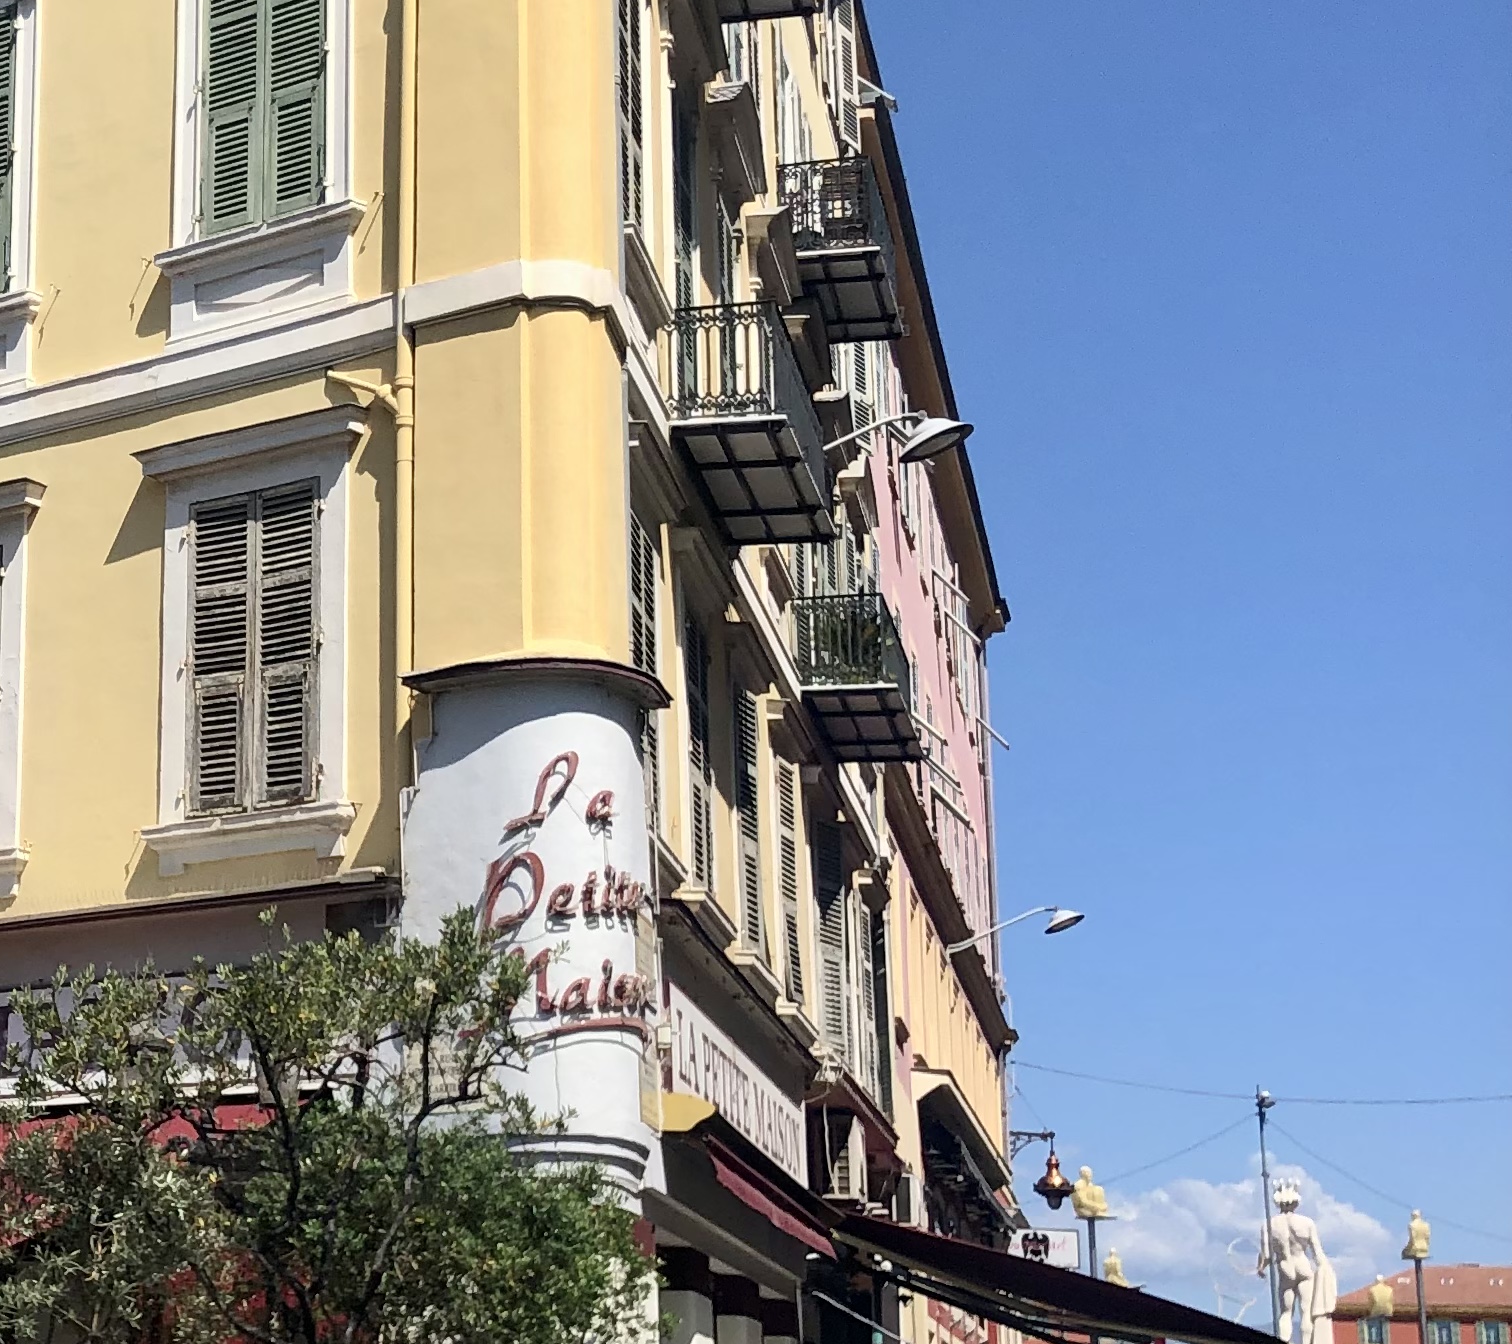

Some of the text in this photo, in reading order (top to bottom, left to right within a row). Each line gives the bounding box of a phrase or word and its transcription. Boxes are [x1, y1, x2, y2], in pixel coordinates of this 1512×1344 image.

[676, 1007, 700, 1096] LA
[701, 1031, 750, 1137] PETITE
[752, 1081, 801, 1177] MAISON
